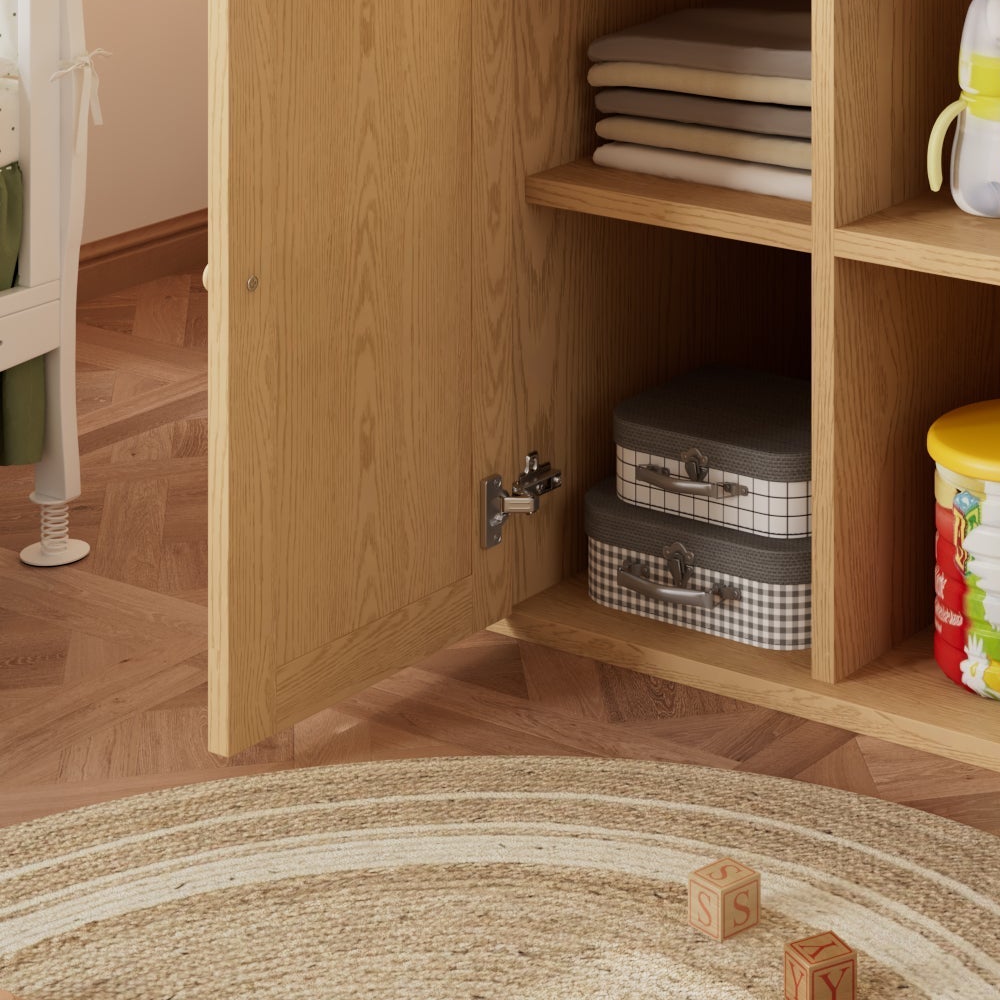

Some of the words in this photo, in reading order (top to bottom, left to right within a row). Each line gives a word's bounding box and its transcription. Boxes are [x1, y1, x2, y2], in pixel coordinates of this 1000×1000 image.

[708, 864, 742, 881] S
[698, 891, 711, 927] S
[733, 889, 751, 929] S
[819, 967, 850, 1000] Y
